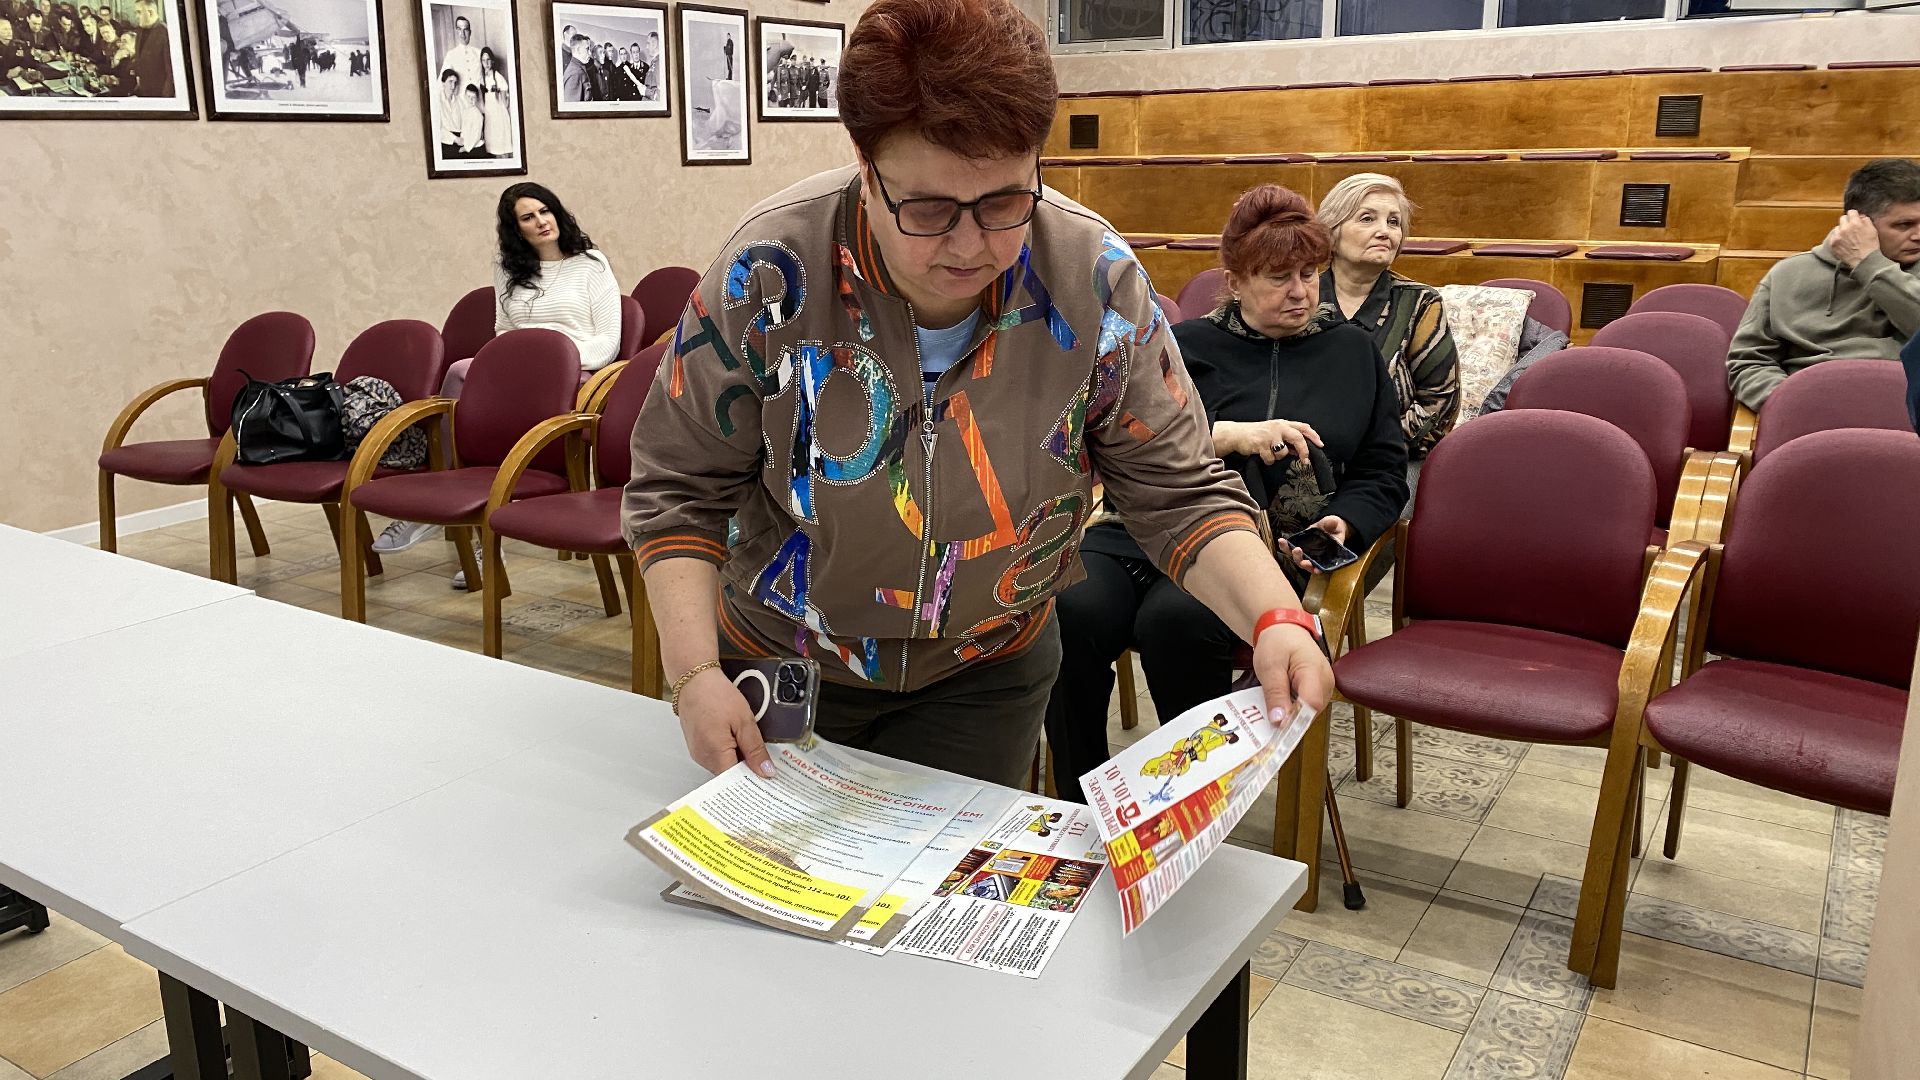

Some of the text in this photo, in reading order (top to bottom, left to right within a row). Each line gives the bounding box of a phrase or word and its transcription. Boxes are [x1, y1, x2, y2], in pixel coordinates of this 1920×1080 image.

[1242, 705, 1264, 724] 112
[782, 749, 820, 775] БУДЬТЕ
[820, 774, 892, 803] ОСТОРОЖНЫ
[902, 801, 947, 813] ОГНЕМ!
[1105, 764, 1120, 780] 01
[1088, 776, 1120, 838] ПРИ ПОЖАРЕ:
[1068, 822, 1089, 837] 112
[724, 840, 812, 882] ДЕЙСТВИЯ ПРИ ПОЖАРЕ:
[650, 834, 659, 842] НЕ
[658, 841, 697, 872] НАРУШАЙТЕ
[697, 870, 724, 888] ПРАВИЛ
[723, 886, 764, 908] ПОЖАРНОЙ
[764, 906, 824, 926] БЕЗОПАСНОСТИ!
[808, 886, 822, 894] 112
